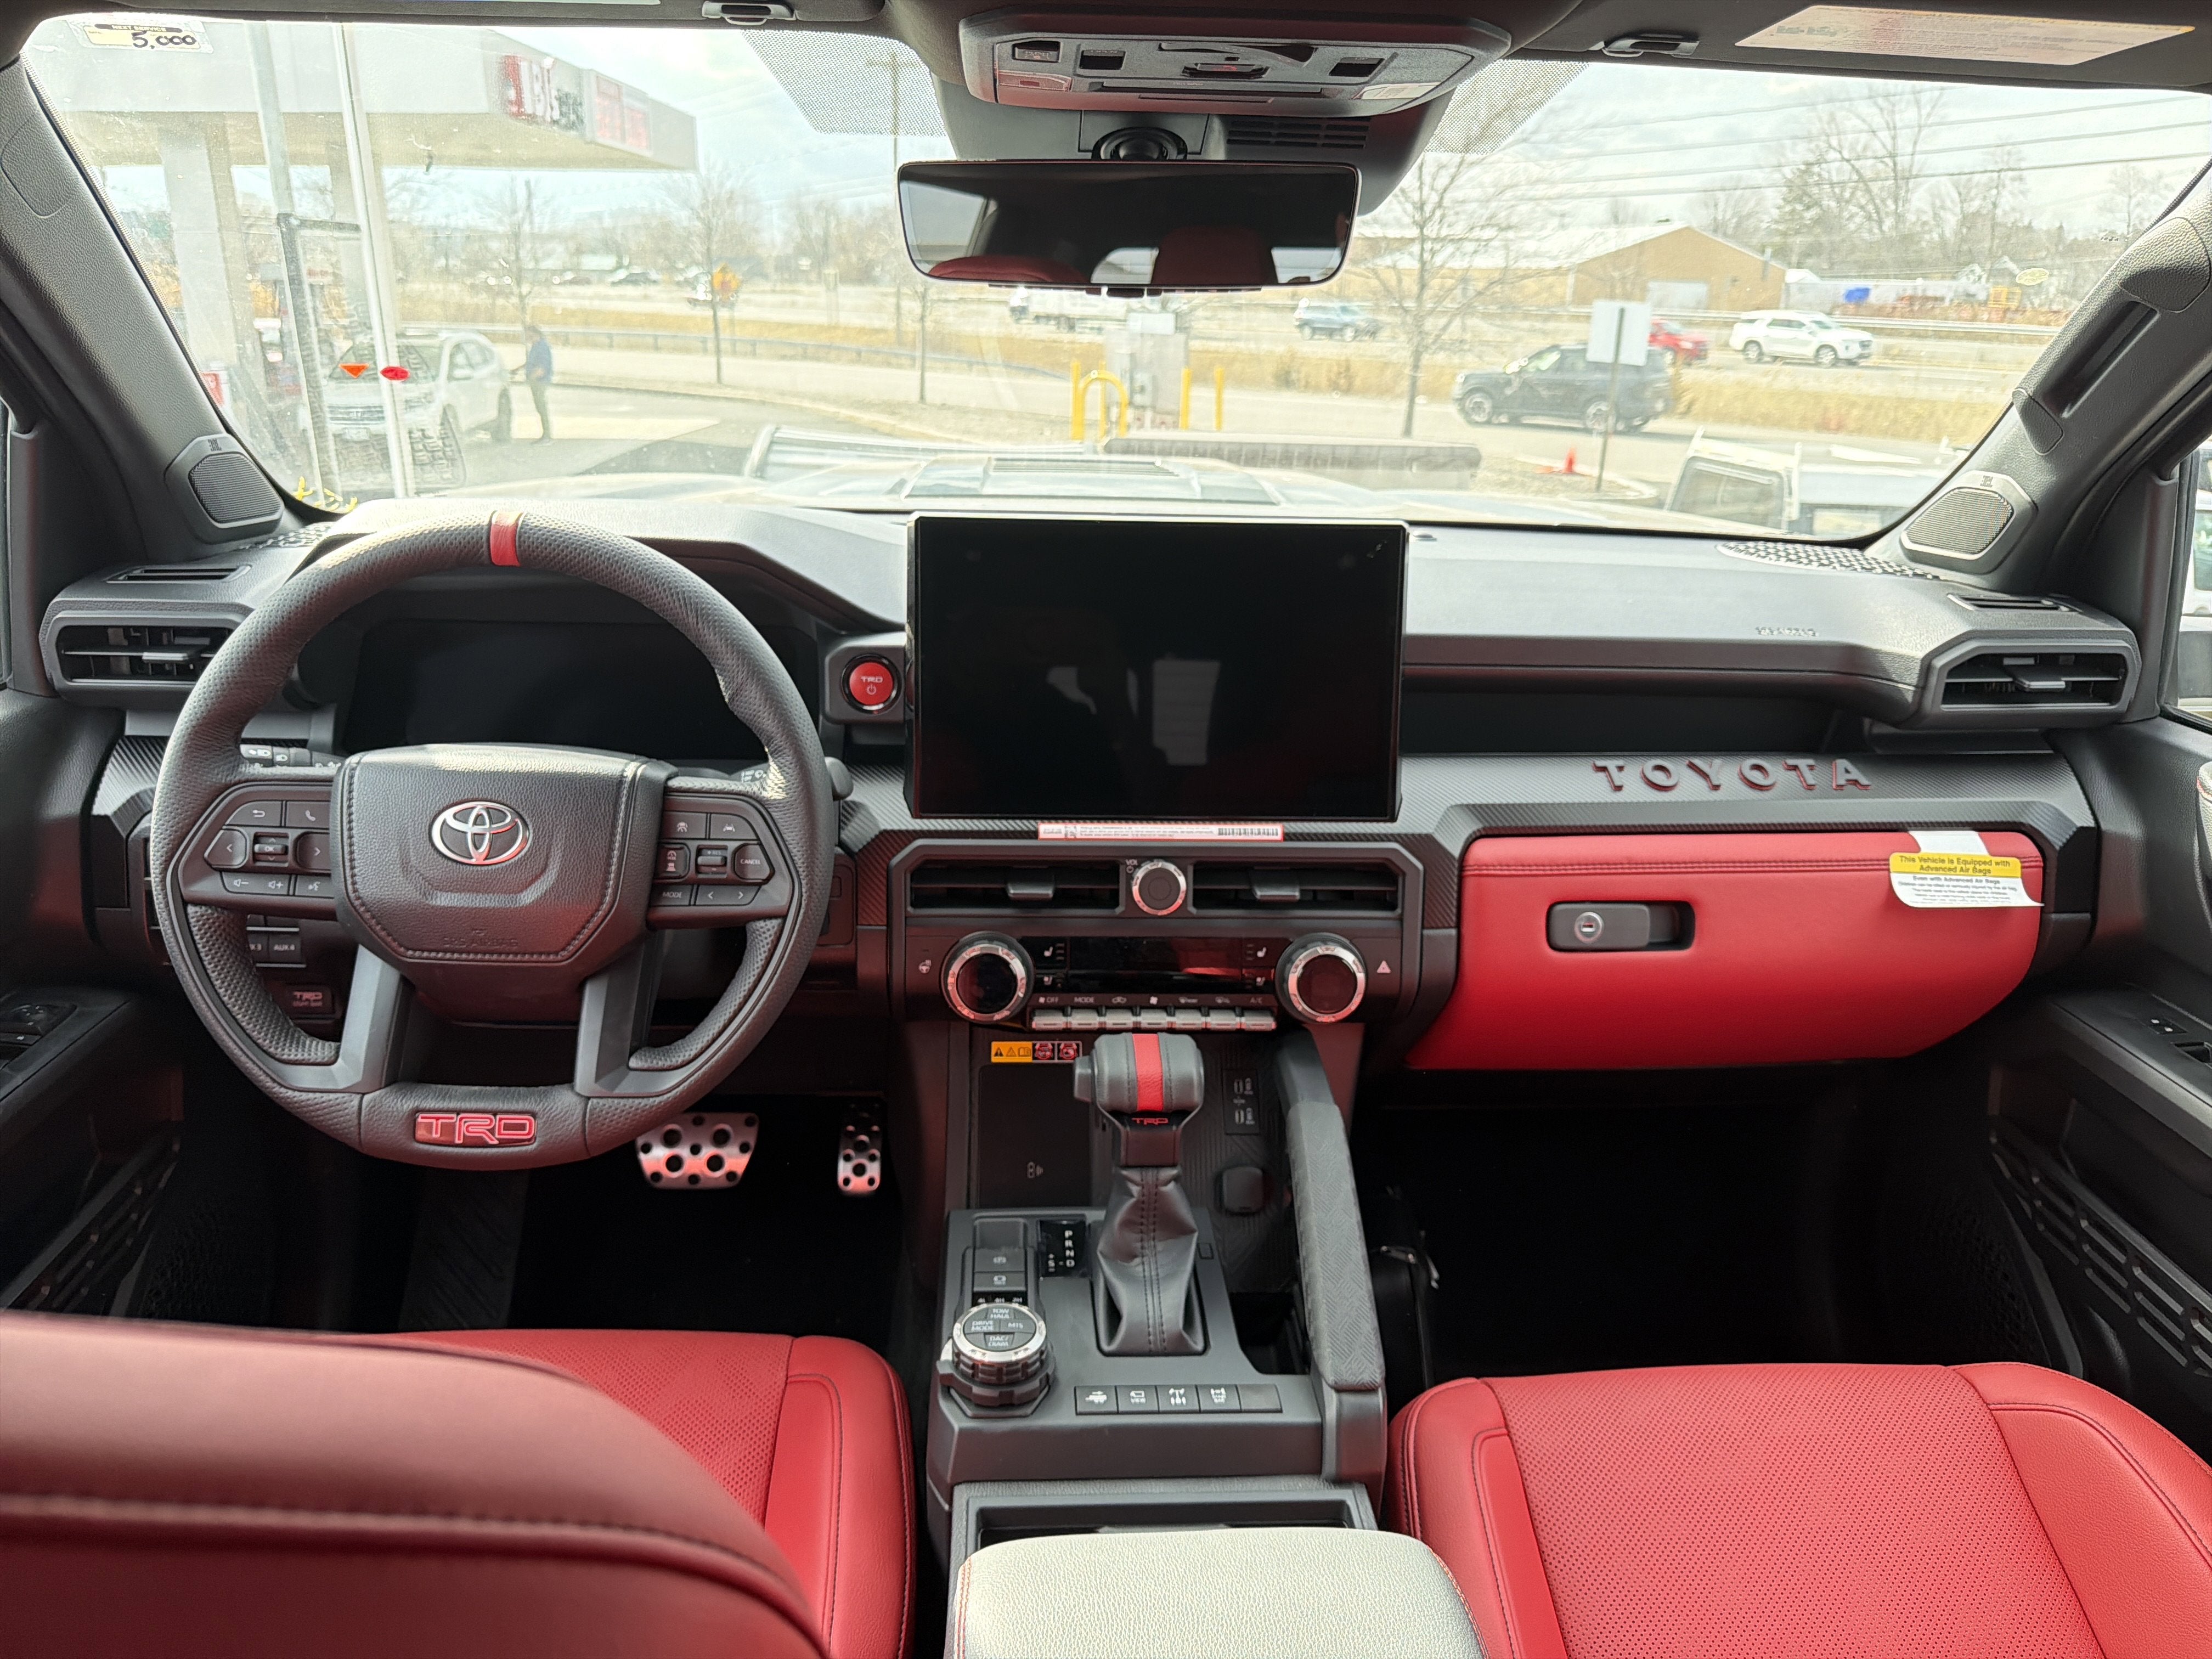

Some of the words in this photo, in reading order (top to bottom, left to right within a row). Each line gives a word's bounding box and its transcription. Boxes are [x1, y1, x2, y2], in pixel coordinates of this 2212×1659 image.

[131, 30, 197, 49] 5,000
[1593, 758, 1871, 792] TOYOTA
[1899, 855, 1916, 864] This
[1918, 856, 1946, 865] Vehicle
[1956, 857, 1992, 867] Equipped
[1919, 865, 1957, 873] Advanced
[1972, 867, 1991, 876] Bags
[293, 991, 323, 1000] TRD
[417, 1114, 535, 1144] TRD
[1065, 1230, 1073, 1238] P
[1065, 1249, 1074, 1257] N
[1066, 1259, 1075, 1267] D
